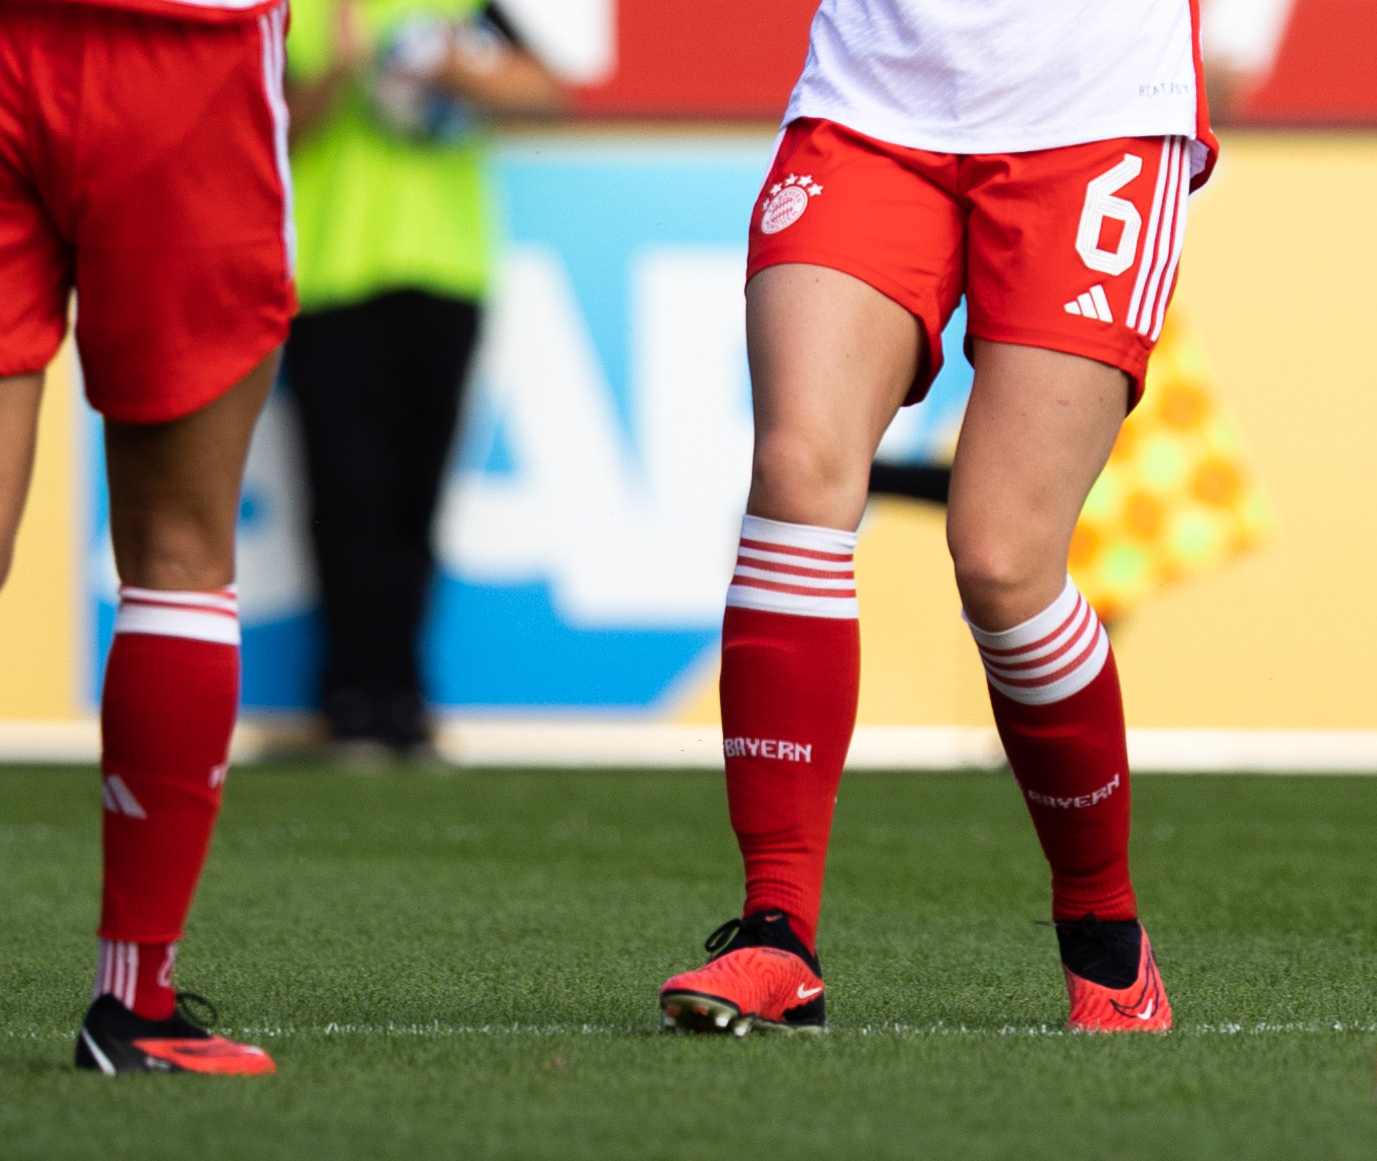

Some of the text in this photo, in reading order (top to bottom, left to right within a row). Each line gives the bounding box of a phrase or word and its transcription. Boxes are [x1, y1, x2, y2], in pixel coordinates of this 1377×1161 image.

[1075, 153, 1143, 276] 6
[724, 736, 813, 764] BAYERN
[1028, 772, 1120, 809] BAYERN
